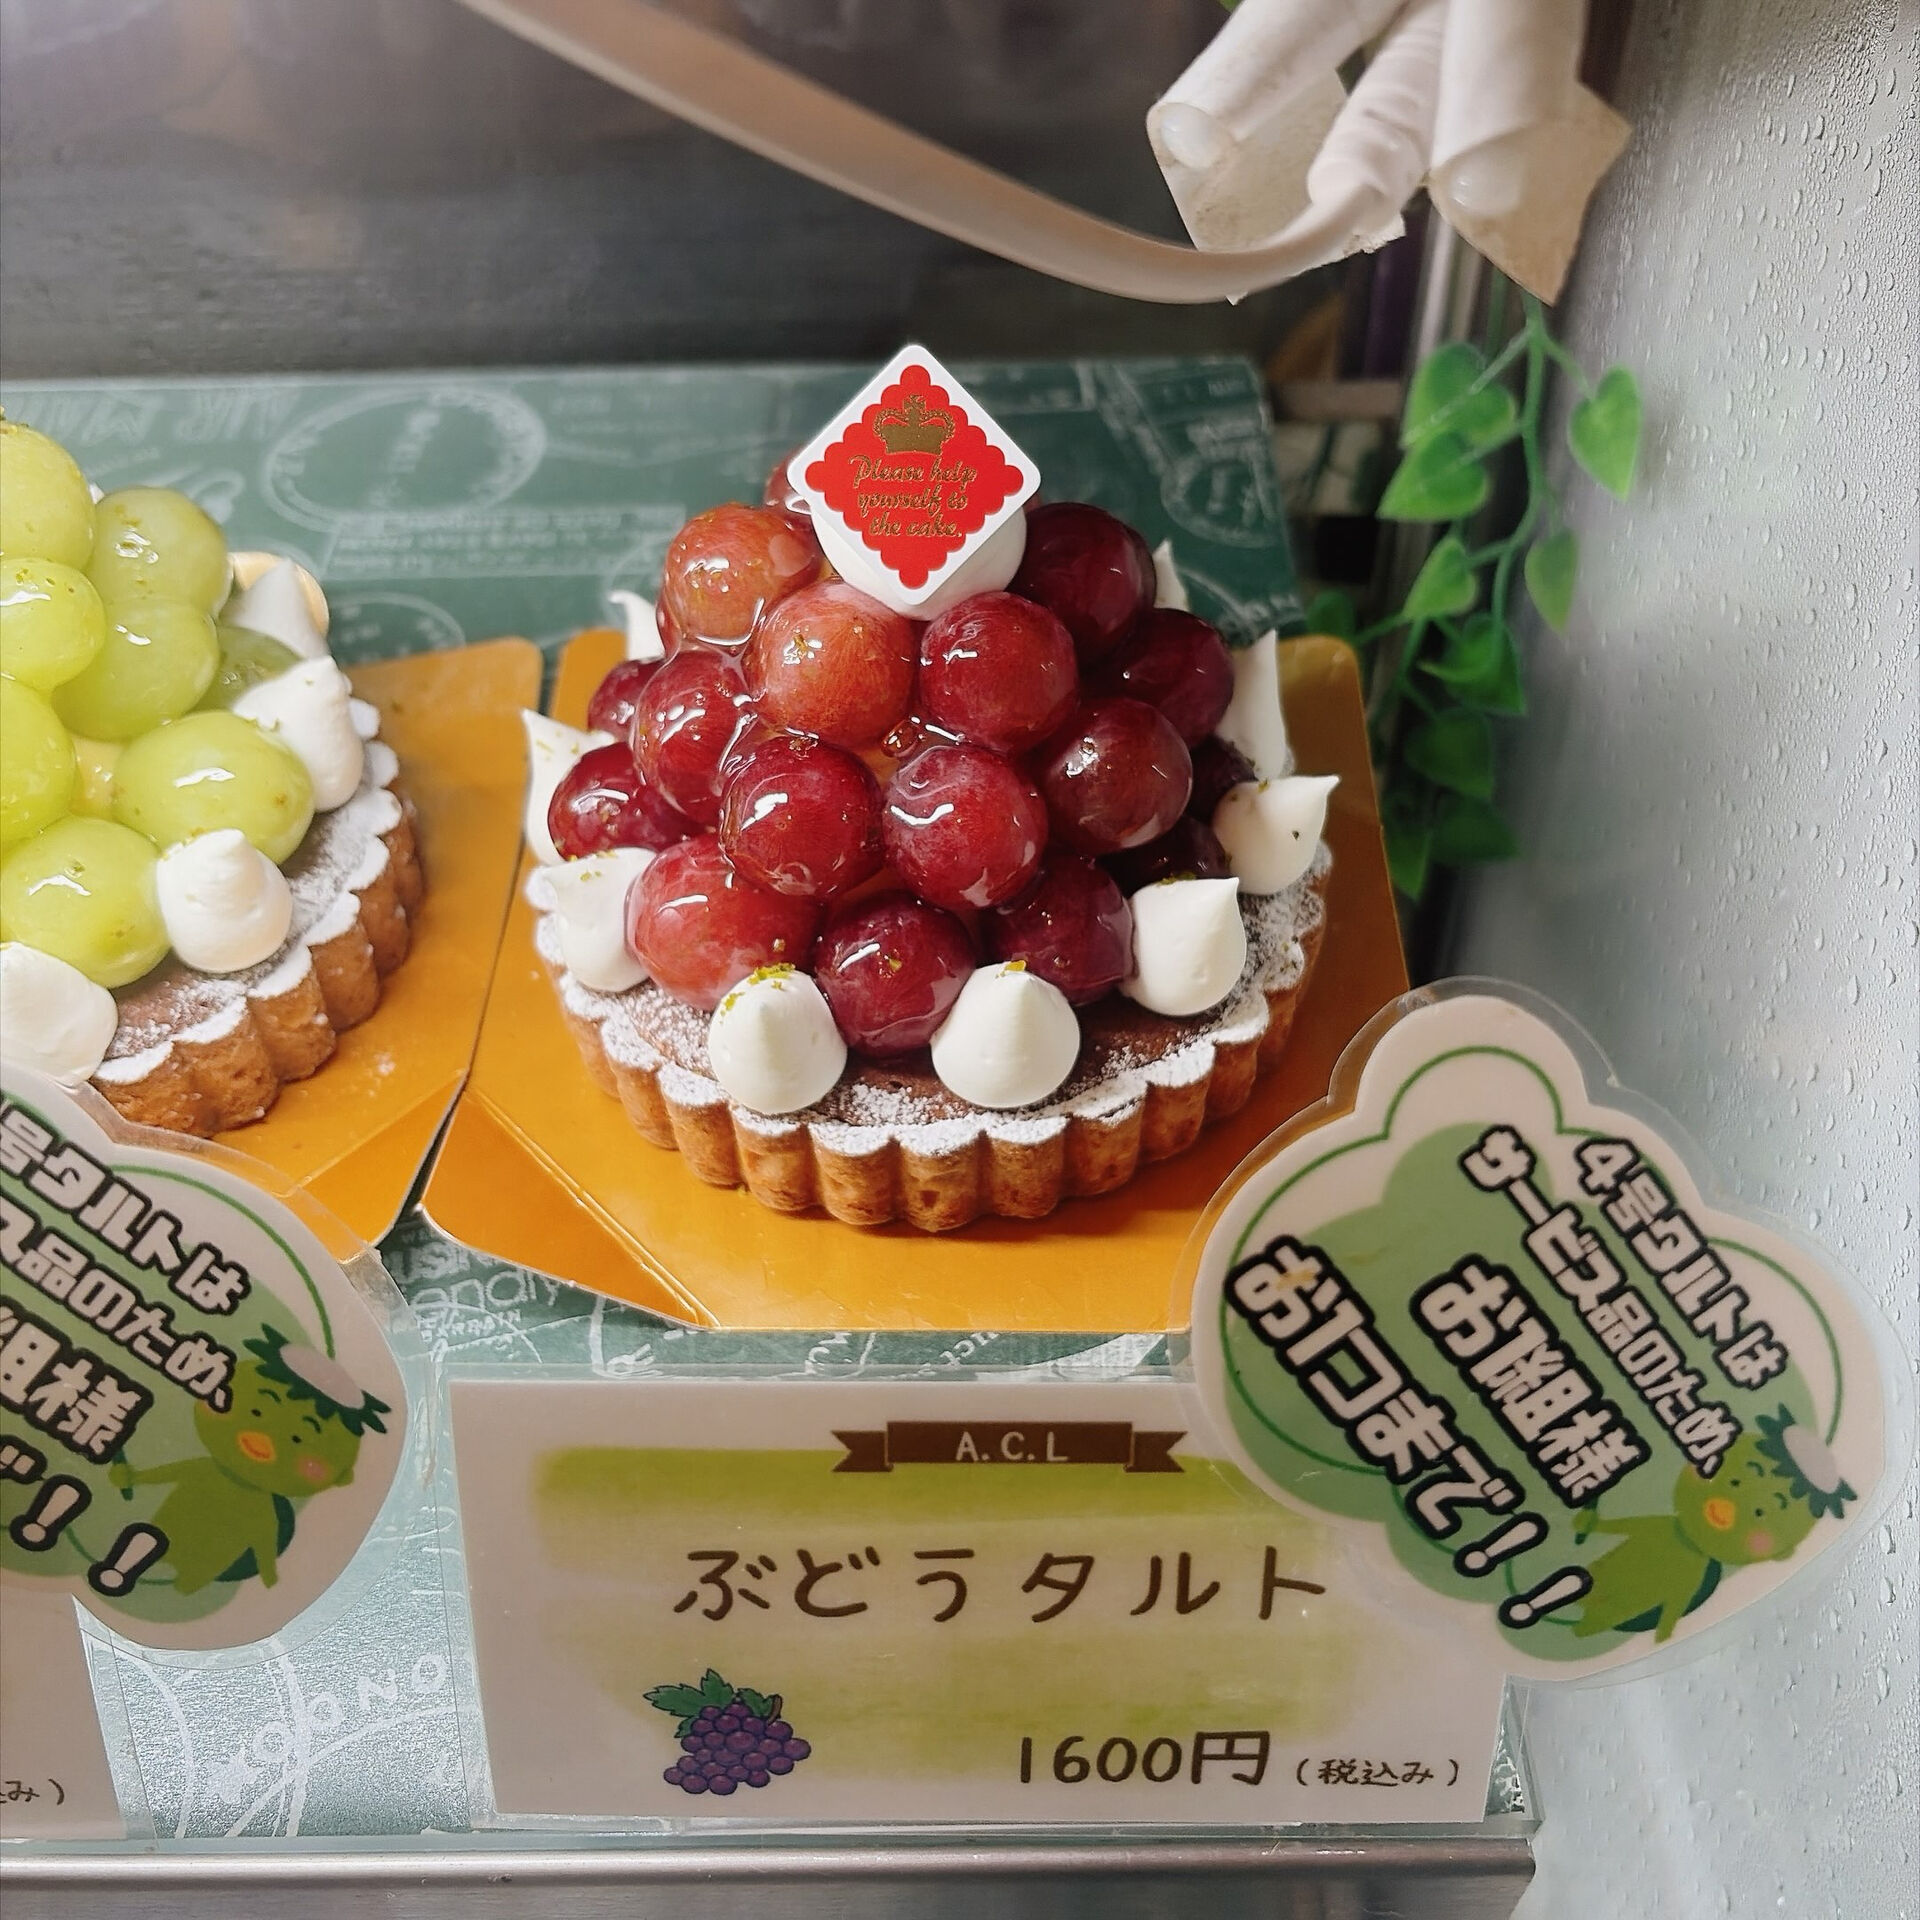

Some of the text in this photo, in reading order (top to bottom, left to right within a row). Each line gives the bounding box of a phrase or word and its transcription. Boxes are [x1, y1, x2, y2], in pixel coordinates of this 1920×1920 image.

[848, 454, 978, 492] Please help
[857, 483, 943, 518] yourself
[868, 511, 902, 536] the
[1573, 1138, 1790, 1390] 4号タルトは
[1410, 1253, 1651, 1508] お1組様
[673, 1545, 1327, 1624] ぶどうタルト
[1020, 1730, 1270, 1786] 1600円
